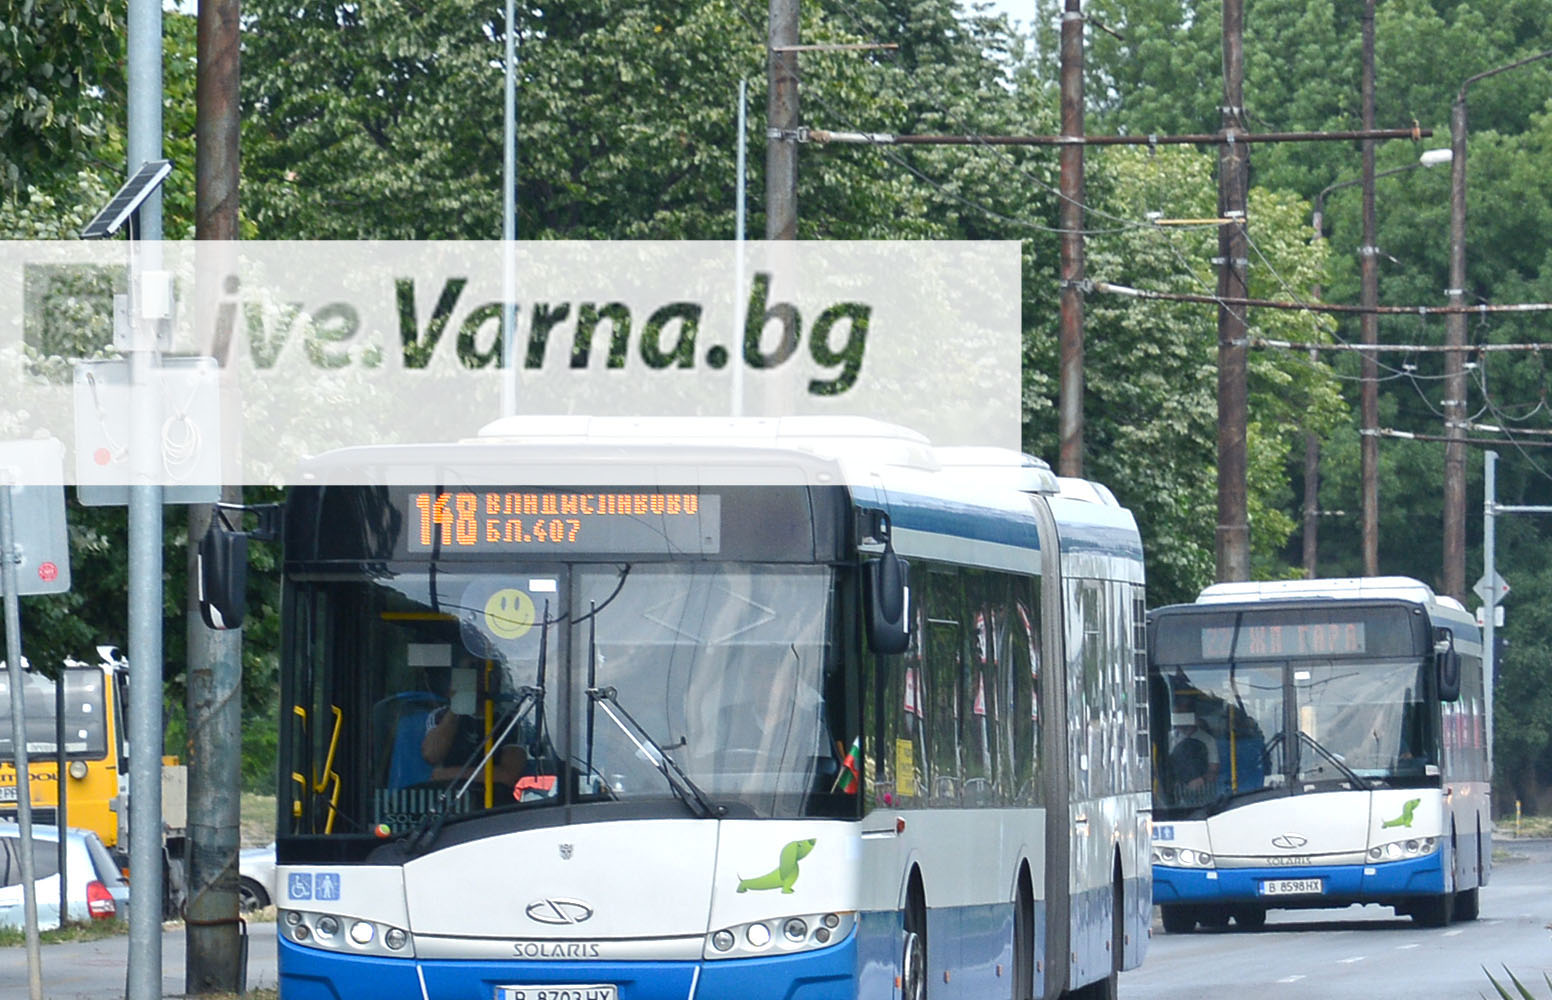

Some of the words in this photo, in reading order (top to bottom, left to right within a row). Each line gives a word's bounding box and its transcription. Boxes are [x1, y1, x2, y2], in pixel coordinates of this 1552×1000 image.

[415, 493, 478, 545] 148
[486, 519, 581, 542] БЛ.407
[1265, 856, 1312, 866] SOLARIS
[513, 943, 599, 957] SOLARIS
